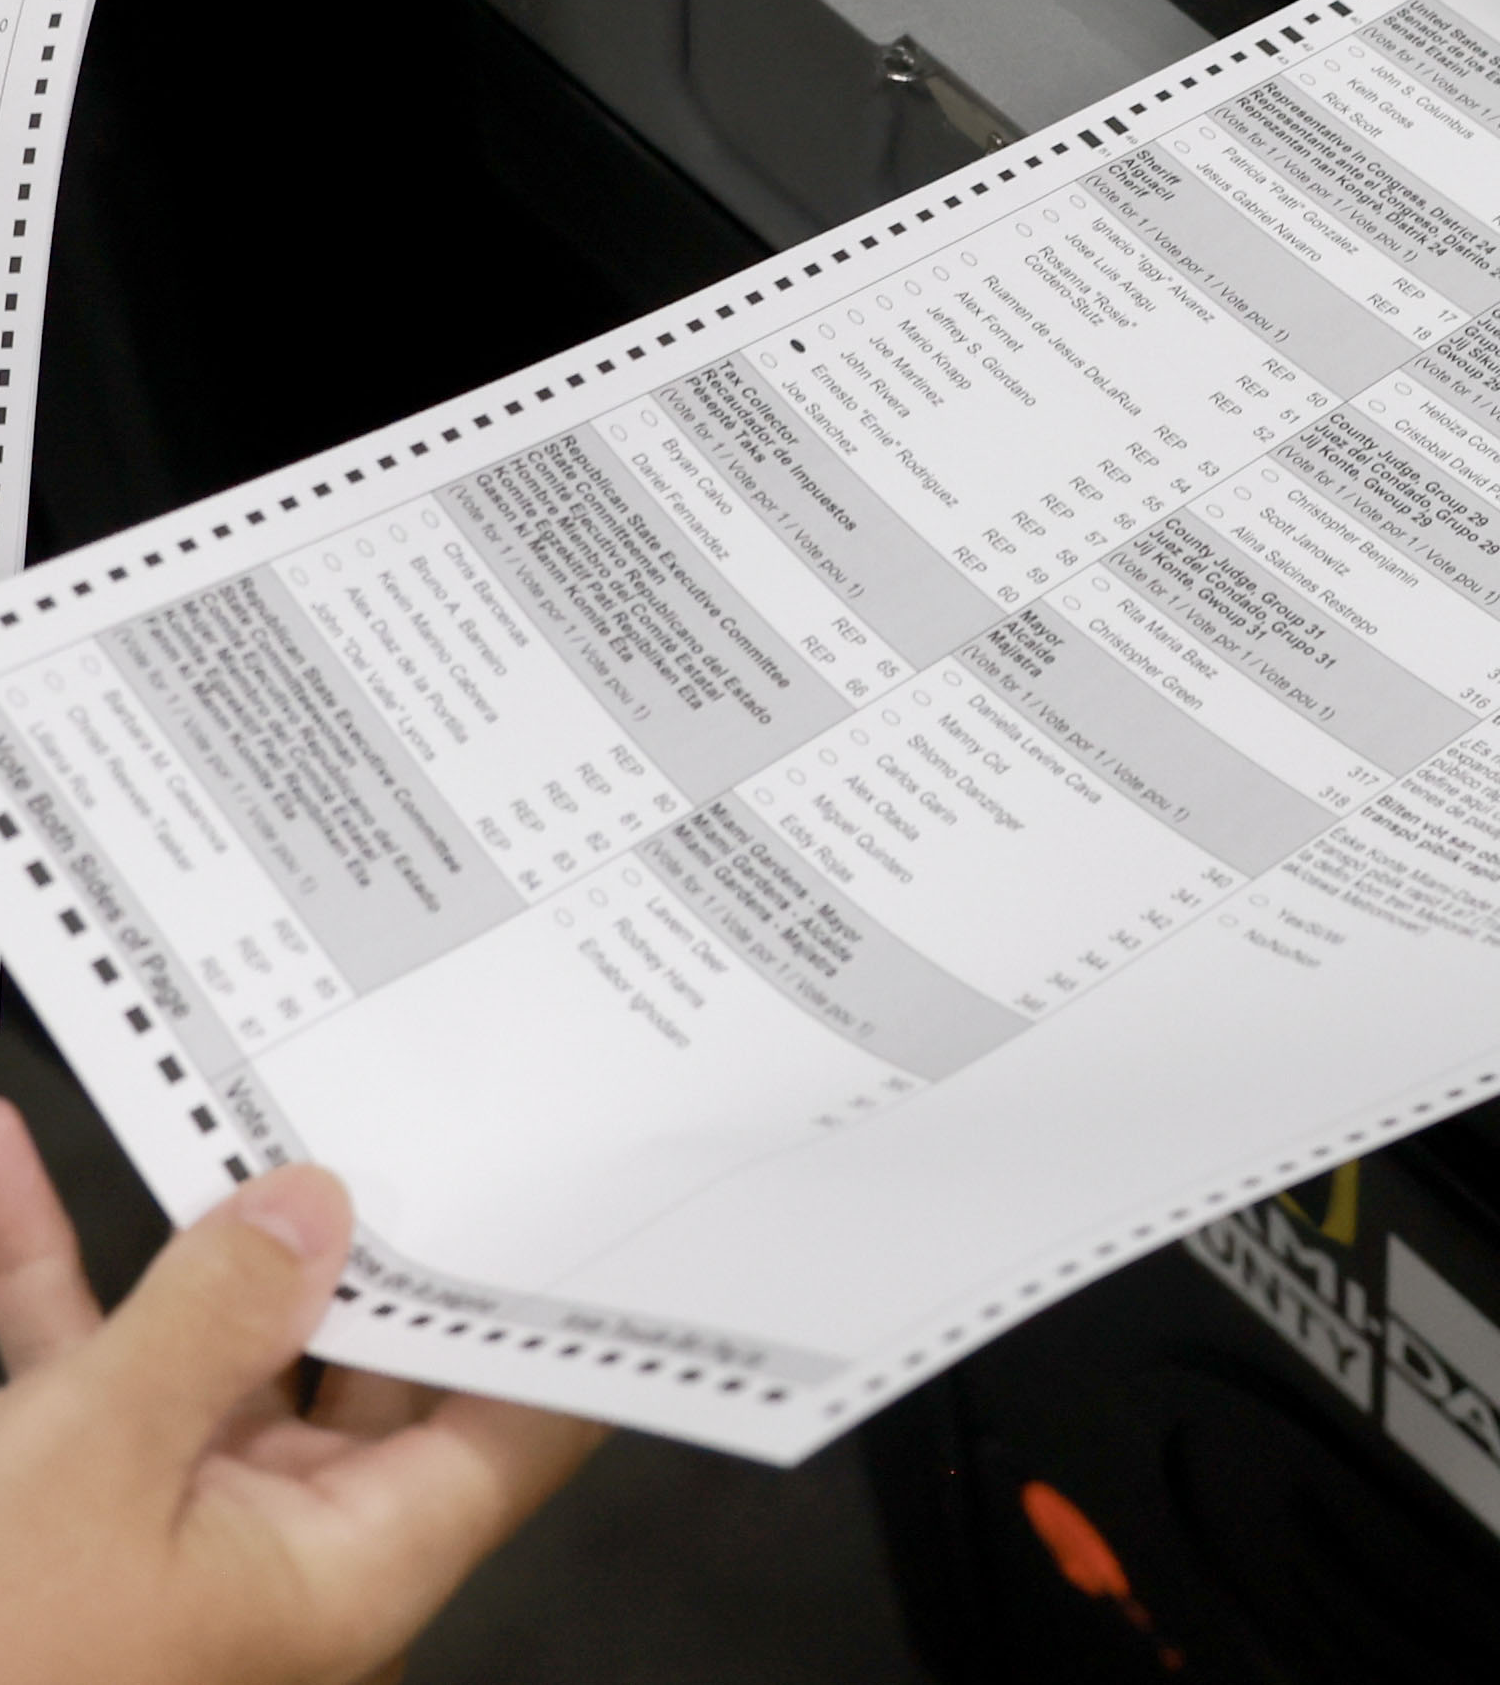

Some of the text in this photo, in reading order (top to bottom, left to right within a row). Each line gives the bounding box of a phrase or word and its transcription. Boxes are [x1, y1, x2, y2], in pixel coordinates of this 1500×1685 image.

[1321, 91, 1385, 138] Rick Scott
[1108, 165, 1151, 198] Cherif
[1122, 157, 1175, 201] Alguacil
[1135, 148, 1183, 187] Sheriff
